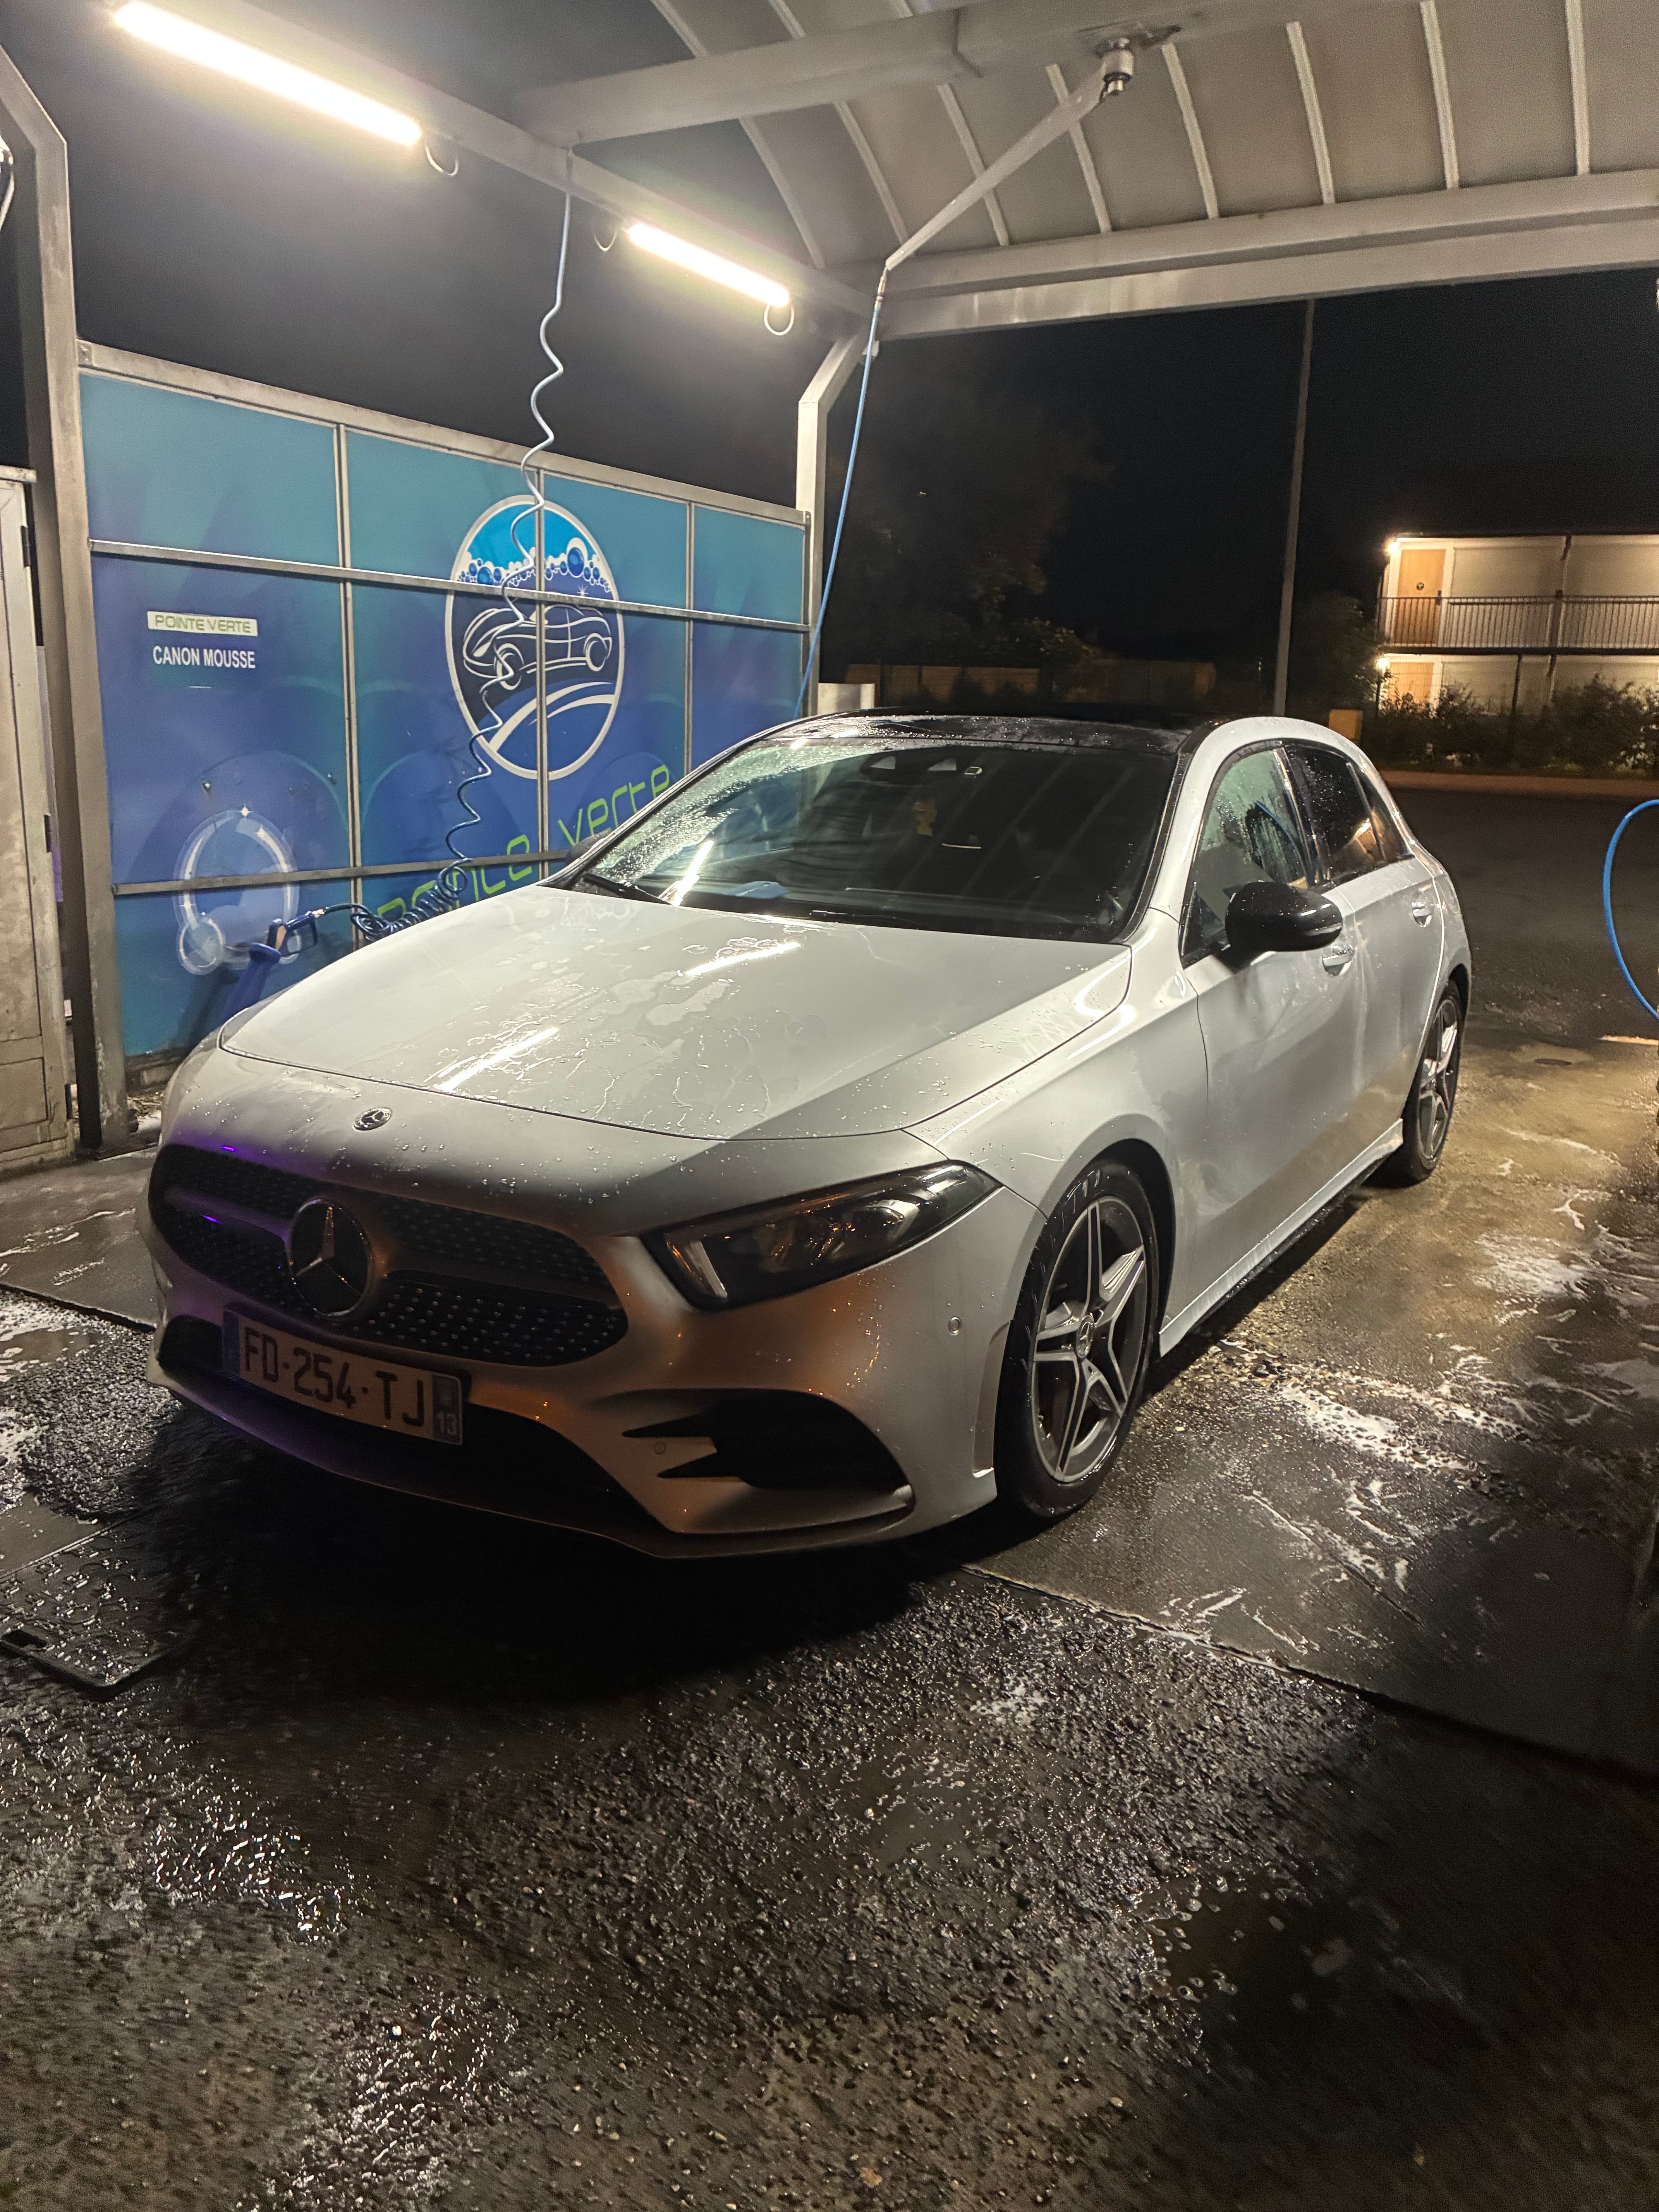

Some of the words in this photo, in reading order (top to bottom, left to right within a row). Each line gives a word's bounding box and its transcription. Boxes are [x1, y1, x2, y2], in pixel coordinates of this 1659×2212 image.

[155, 614, 204, 631] POINTE
[207, 619, 251, 634] VERTE
[153, 646, 200, 666] CANON
[203, 648, 256, 669] MOUSSE
